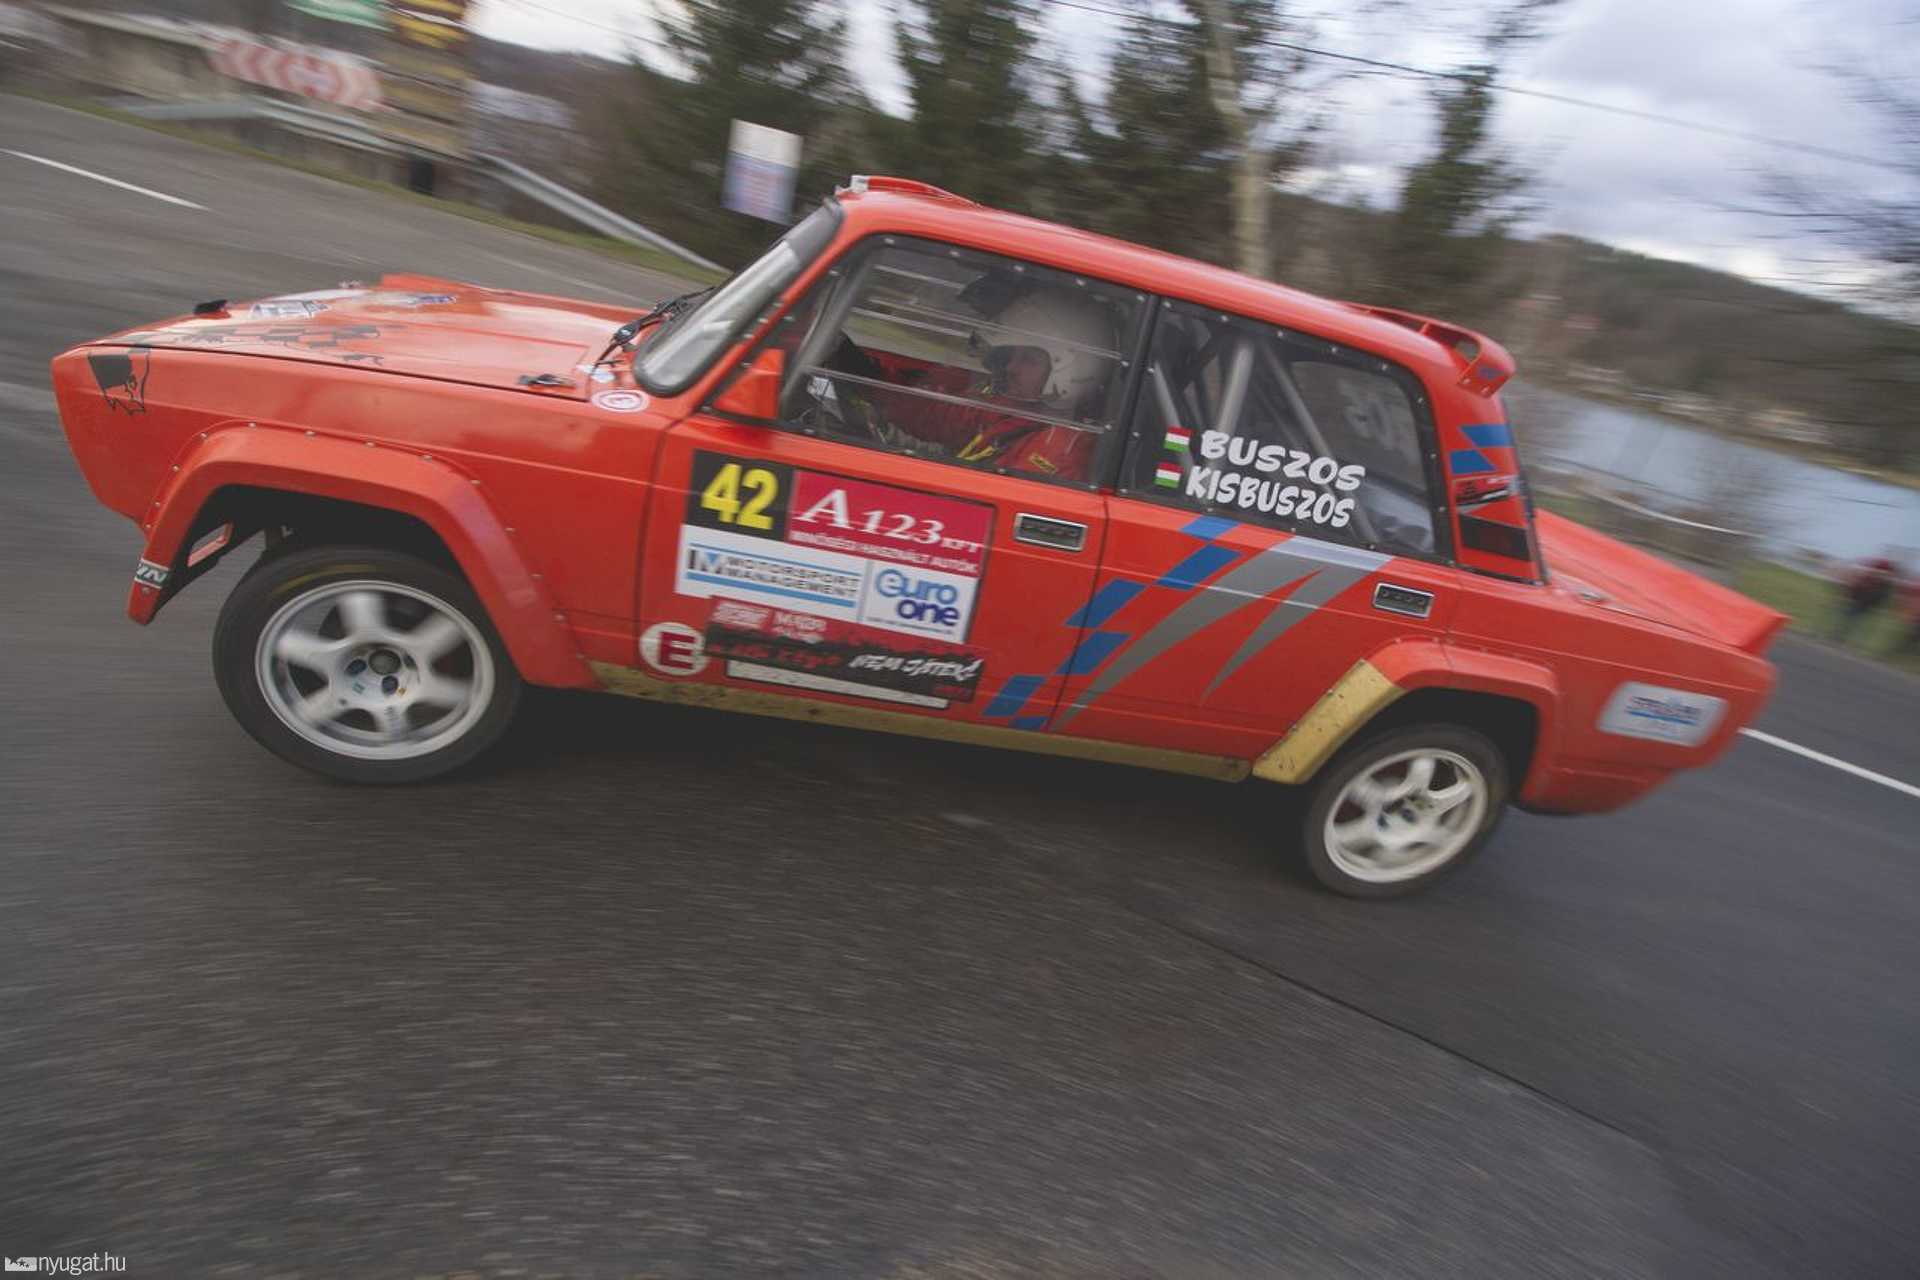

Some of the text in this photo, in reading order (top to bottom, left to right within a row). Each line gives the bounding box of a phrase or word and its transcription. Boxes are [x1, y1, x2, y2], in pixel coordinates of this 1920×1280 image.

[1200, 430, 1366, 491] BUSZOS
[701, 463, 779, 531] 42
[1185, 466, 1355, 528] KISBUSZOS
[897, 600, 960, 626] one
[660, 631, 696, 670] E
